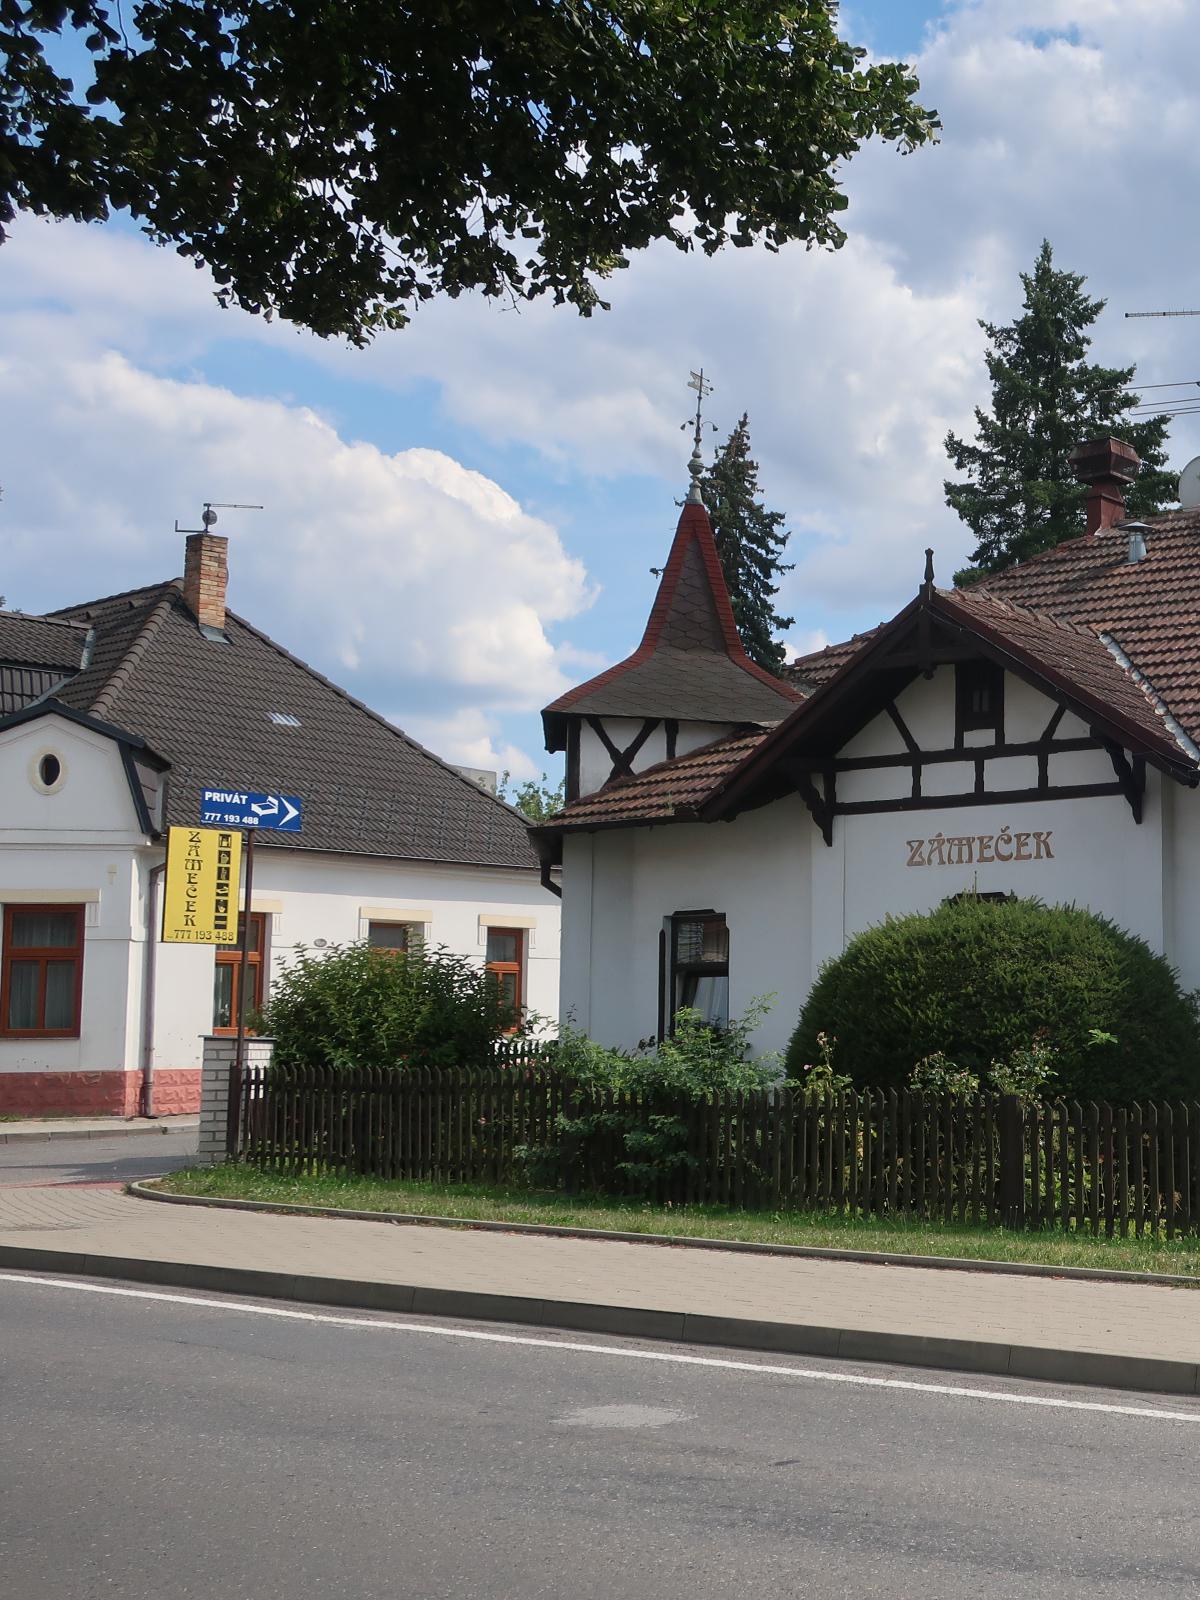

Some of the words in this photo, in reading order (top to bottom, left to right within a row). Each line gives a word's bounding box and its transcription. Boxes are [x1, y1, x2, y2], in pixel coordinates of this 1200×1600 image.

[204, 791, 248, 804] PRIVÁT
[204, 813, 221, 821] 777
[224, 814, 240, 823] 193
[242, 816, 259, 825] 488
[906, 826, 1055, 866] ZÁMEČEK
[184, 831, 203, 927] ZÁMEČEK
[174, 929, 192, 940] 777
[195, 931, 212, 941] 193
[215, 932, 234, 941] 488
